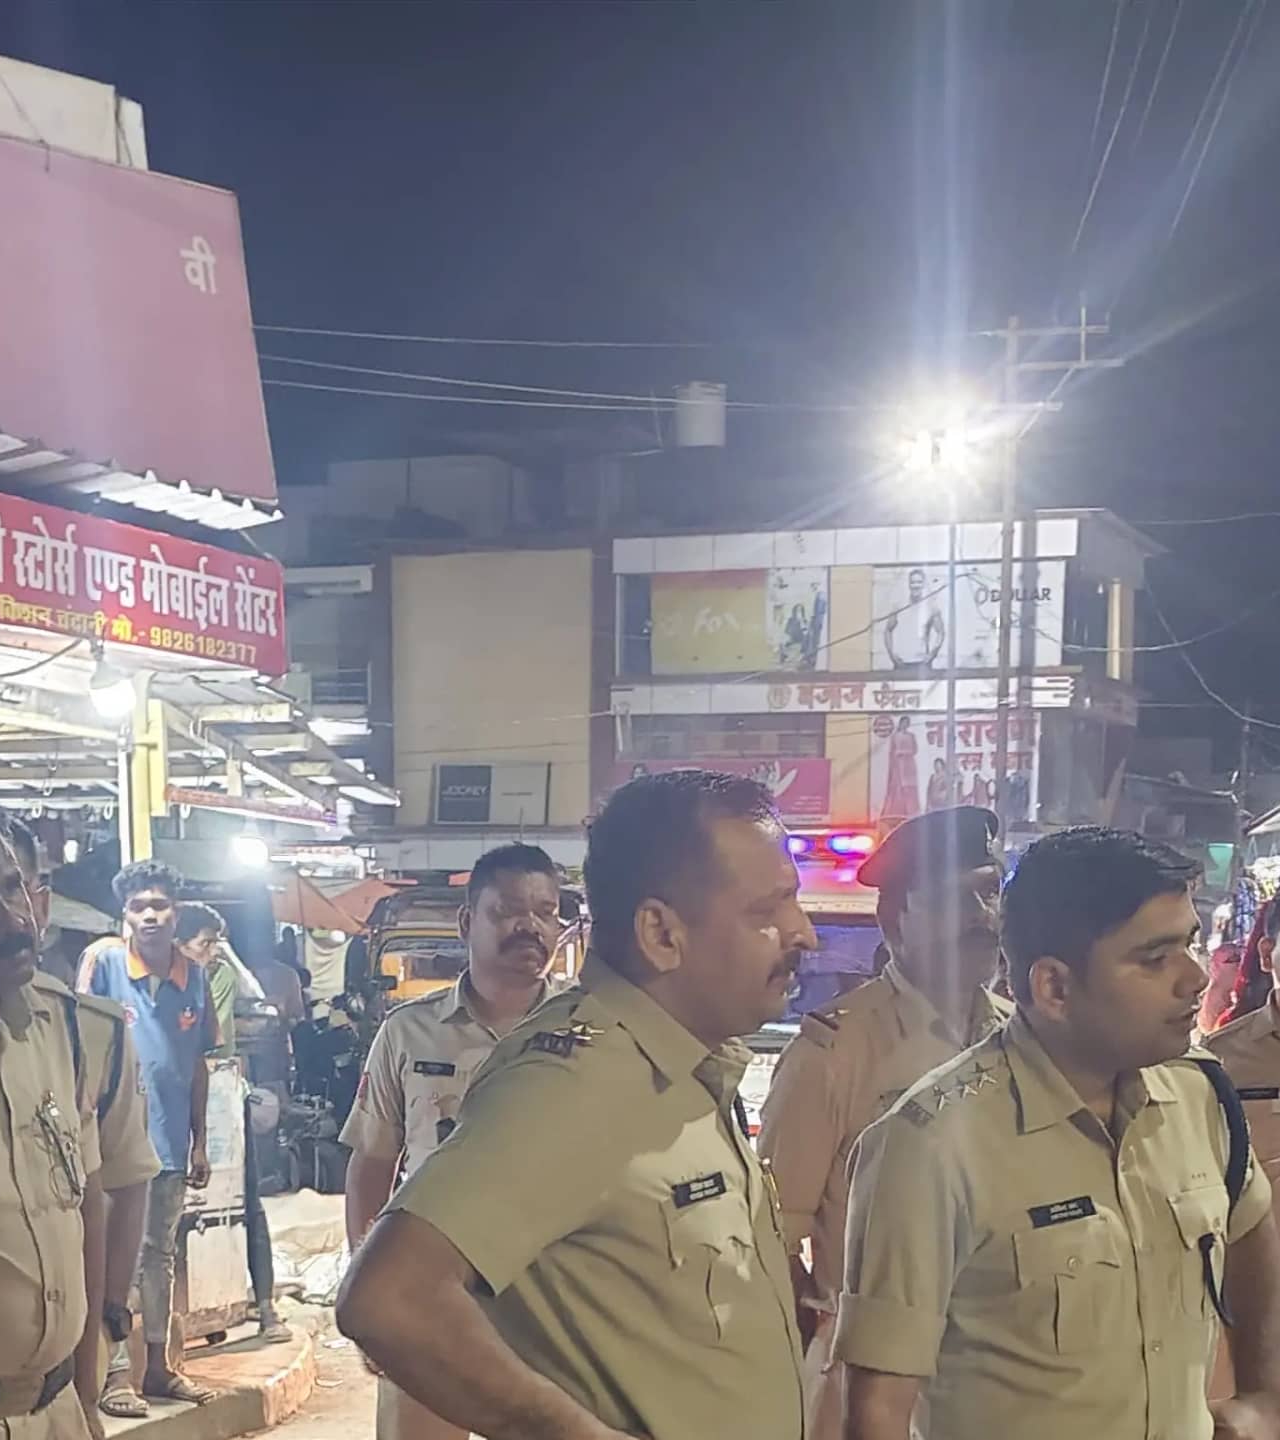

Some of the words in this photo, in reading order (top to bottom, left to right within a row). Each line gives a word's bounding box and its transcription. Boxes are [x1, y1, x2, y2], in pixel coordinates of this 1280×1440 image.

[179, 236, 217, 295] वी
[11, 516, 77, 597] स्टोर्स
[83, 546, 137, 610] एण्ड
[141, 543, 231, 630] मोबाईल
[233, 565, 278, 638] सेंटर
